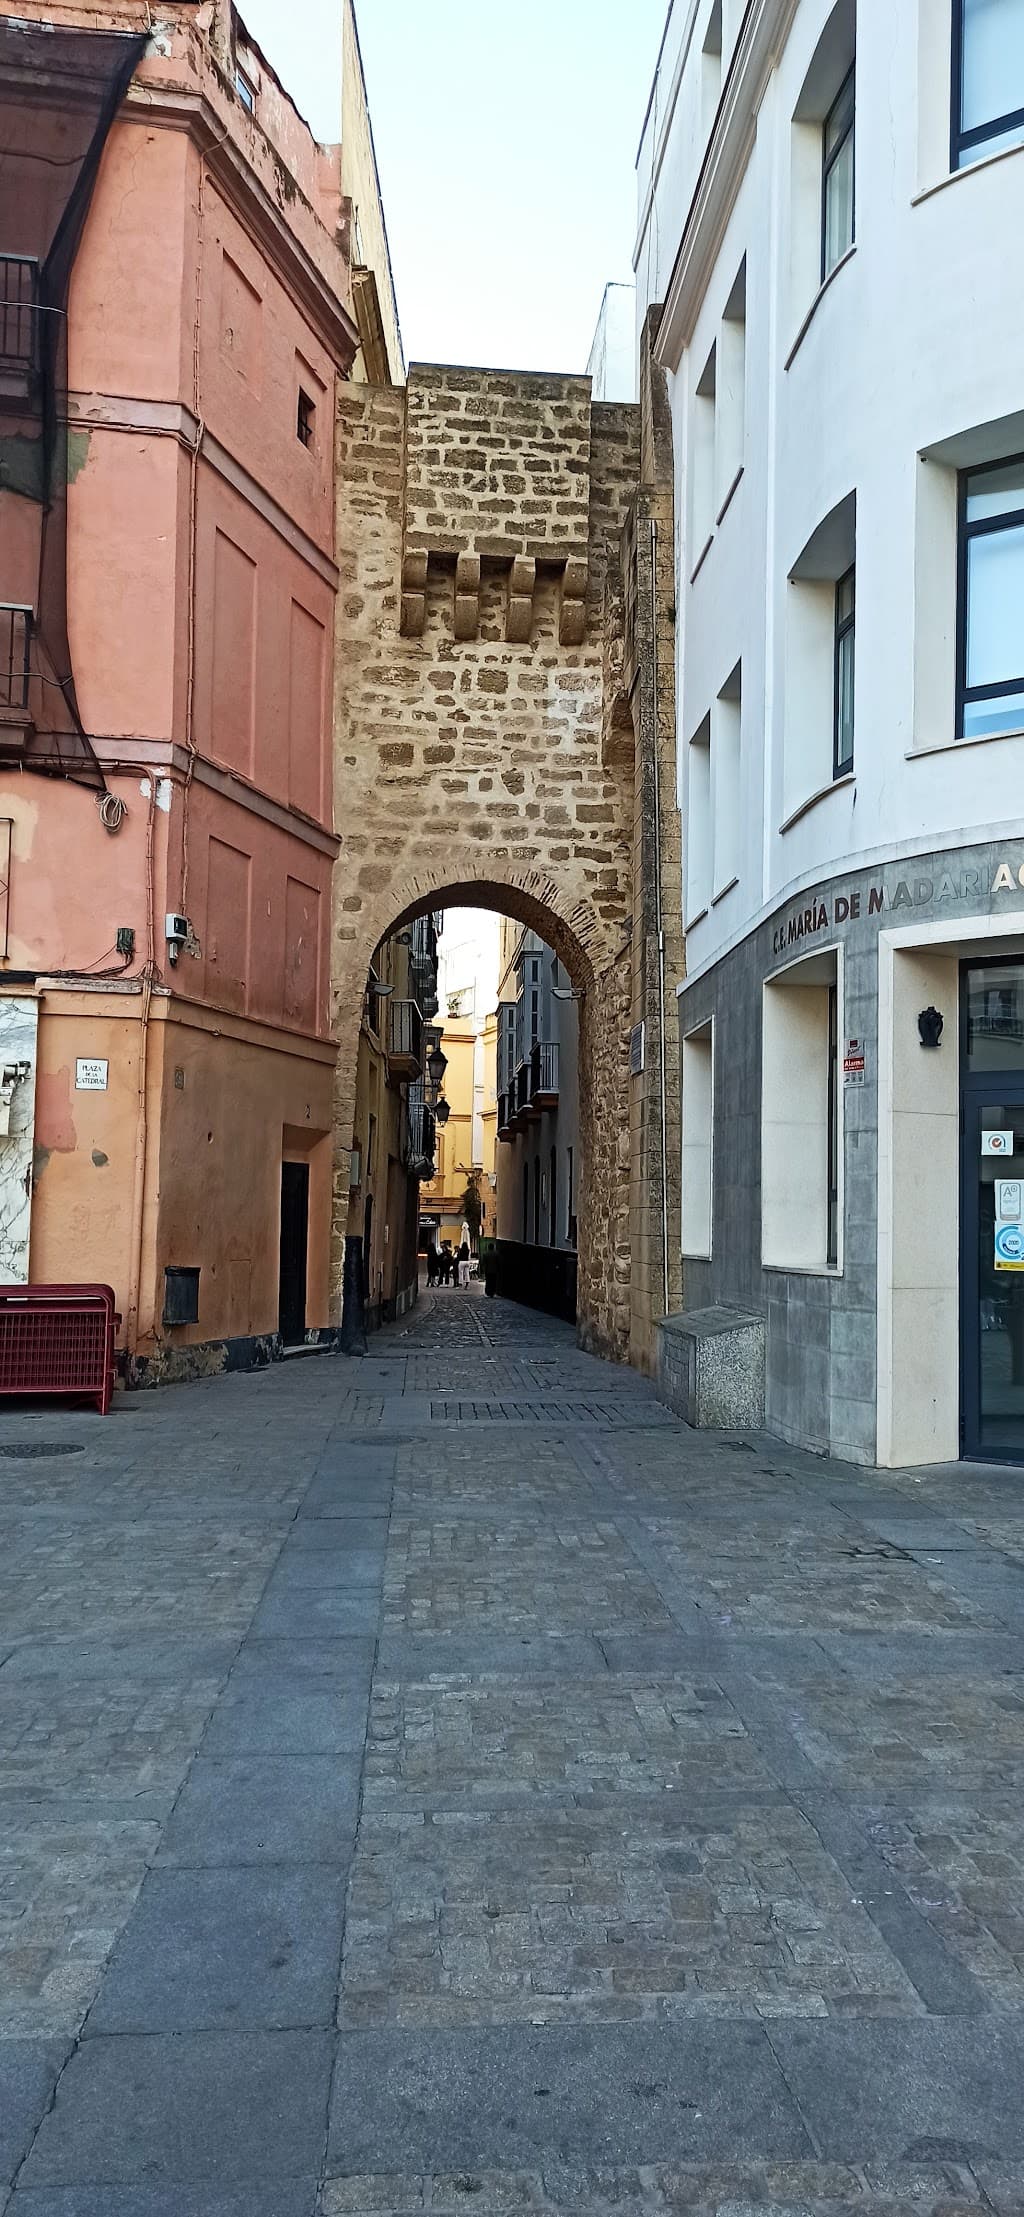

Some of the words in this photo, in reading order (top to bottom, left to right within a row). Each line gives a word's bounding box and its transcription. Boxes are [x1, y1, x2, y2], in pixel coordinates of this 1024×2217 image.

[787, 898, 829, 945] MARÍA
[834, 892, 861, 924] DE
[868, 863, 1024, 915] MADARIA
